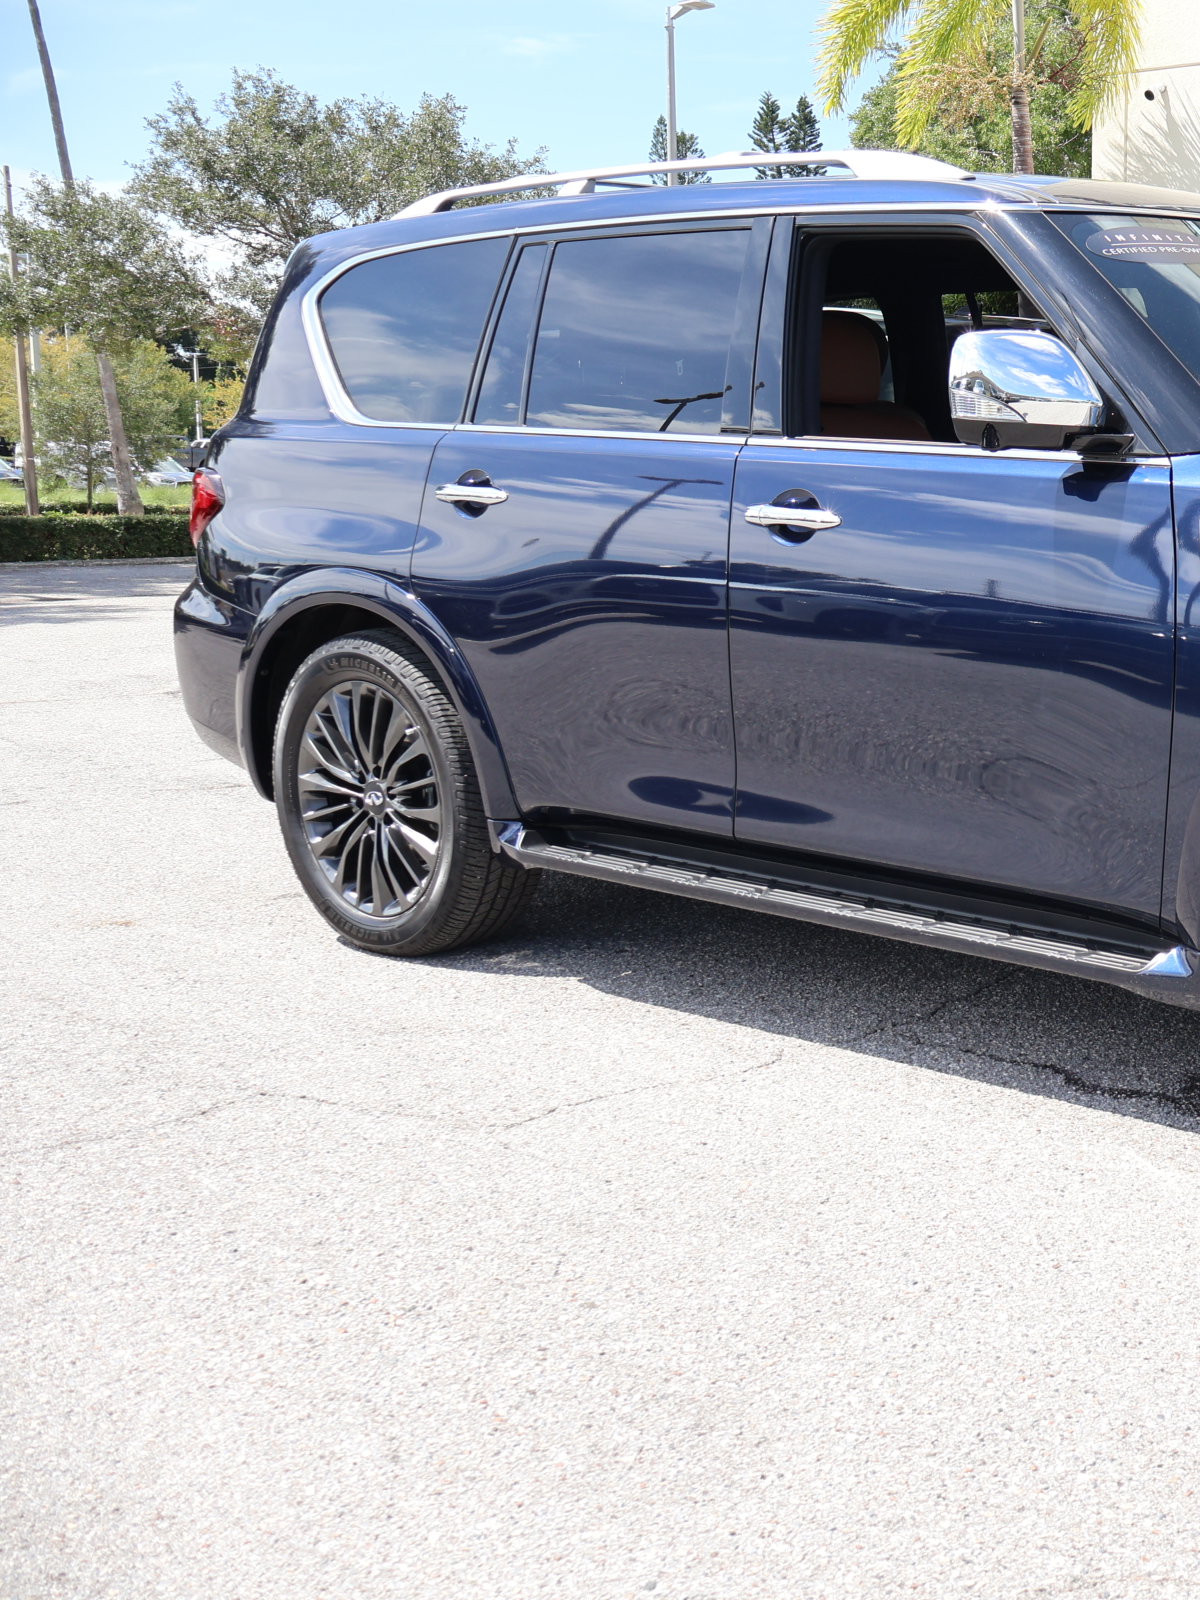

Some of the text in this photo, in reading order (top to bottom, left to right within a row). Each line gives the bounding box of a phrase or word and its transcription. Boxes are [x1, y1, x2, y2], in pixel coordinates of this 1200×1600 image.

[1104, 233, 1194, 243] INFINITI
[1103, 246, 1158, 256] CERTIFIED
[340, 657, 396, 686] MICHELIN
